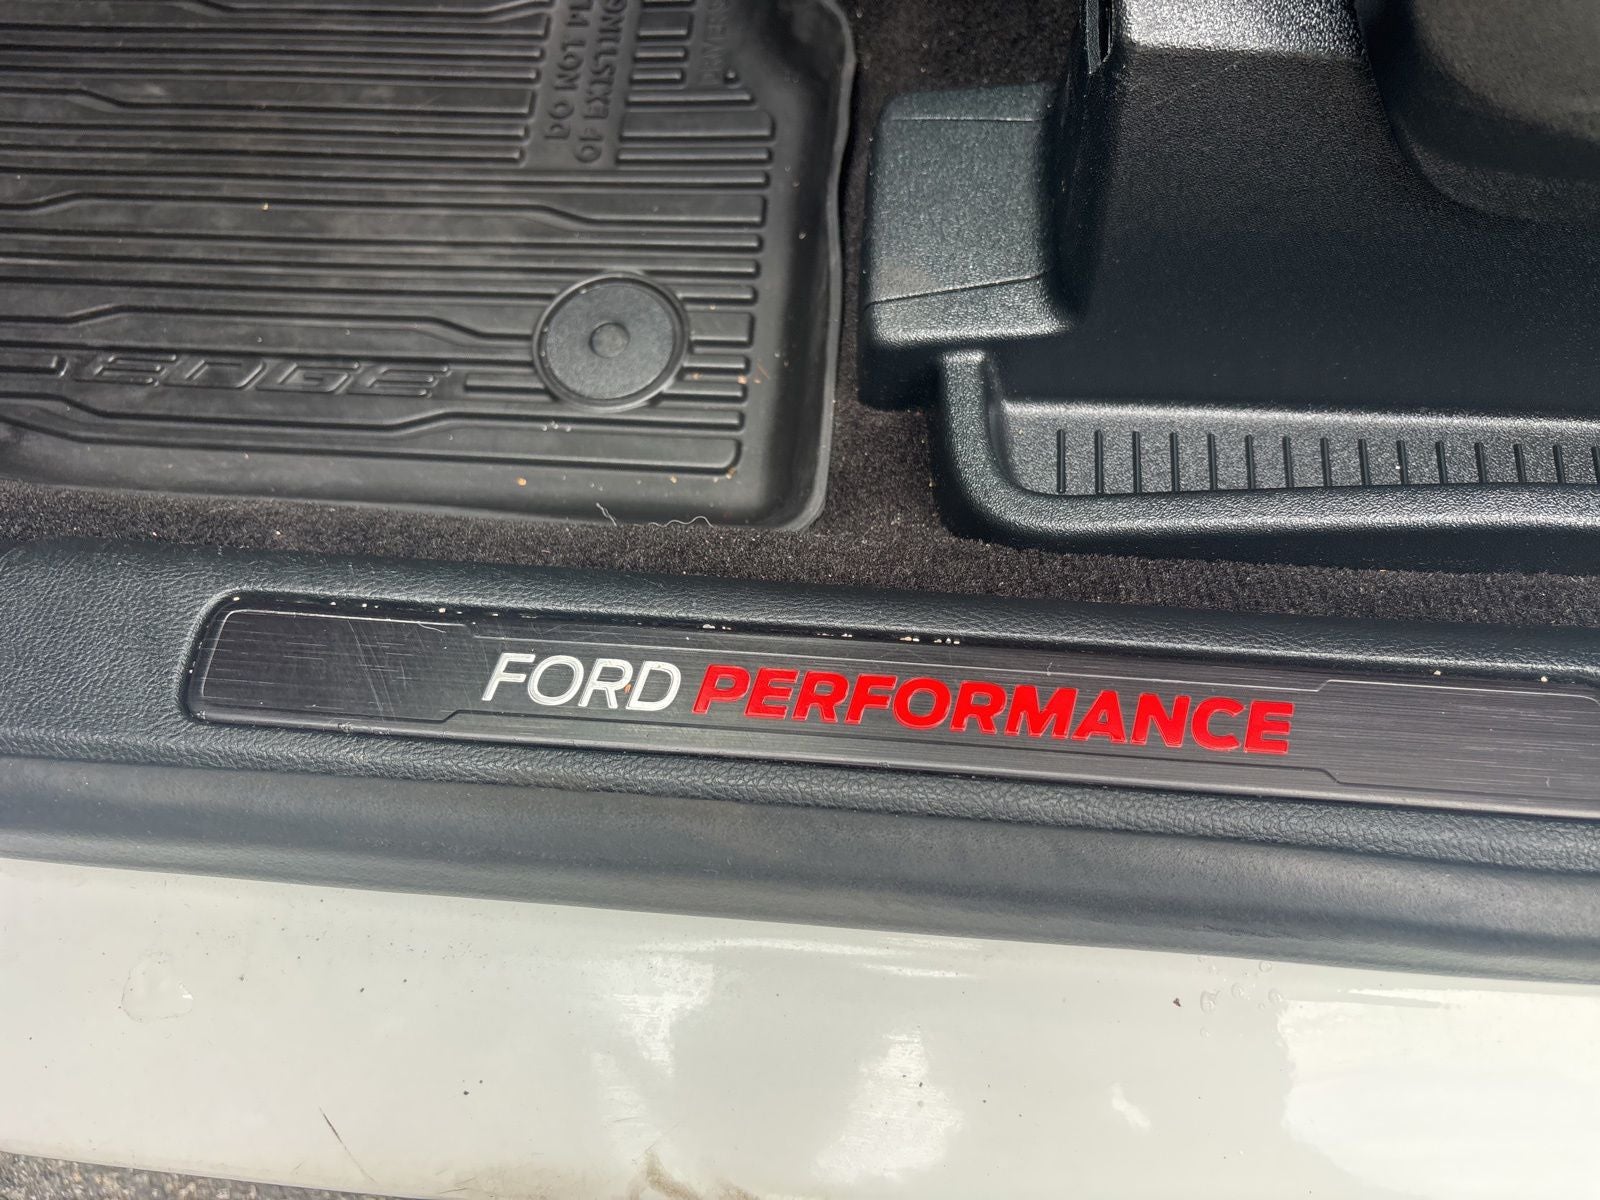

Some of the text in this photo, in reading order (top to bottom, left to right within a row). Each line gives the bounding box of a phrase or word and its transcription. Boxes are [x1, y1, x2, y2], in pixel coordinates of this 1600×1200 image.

[553, 40, 586, 92] NOT
[543, 100, 575, 142] DO
[572, 127, 604, 165] OF
[70, 352, 453, 400] EDGE
[481, 652, 1295, 755] FORD PERFORMANCE
